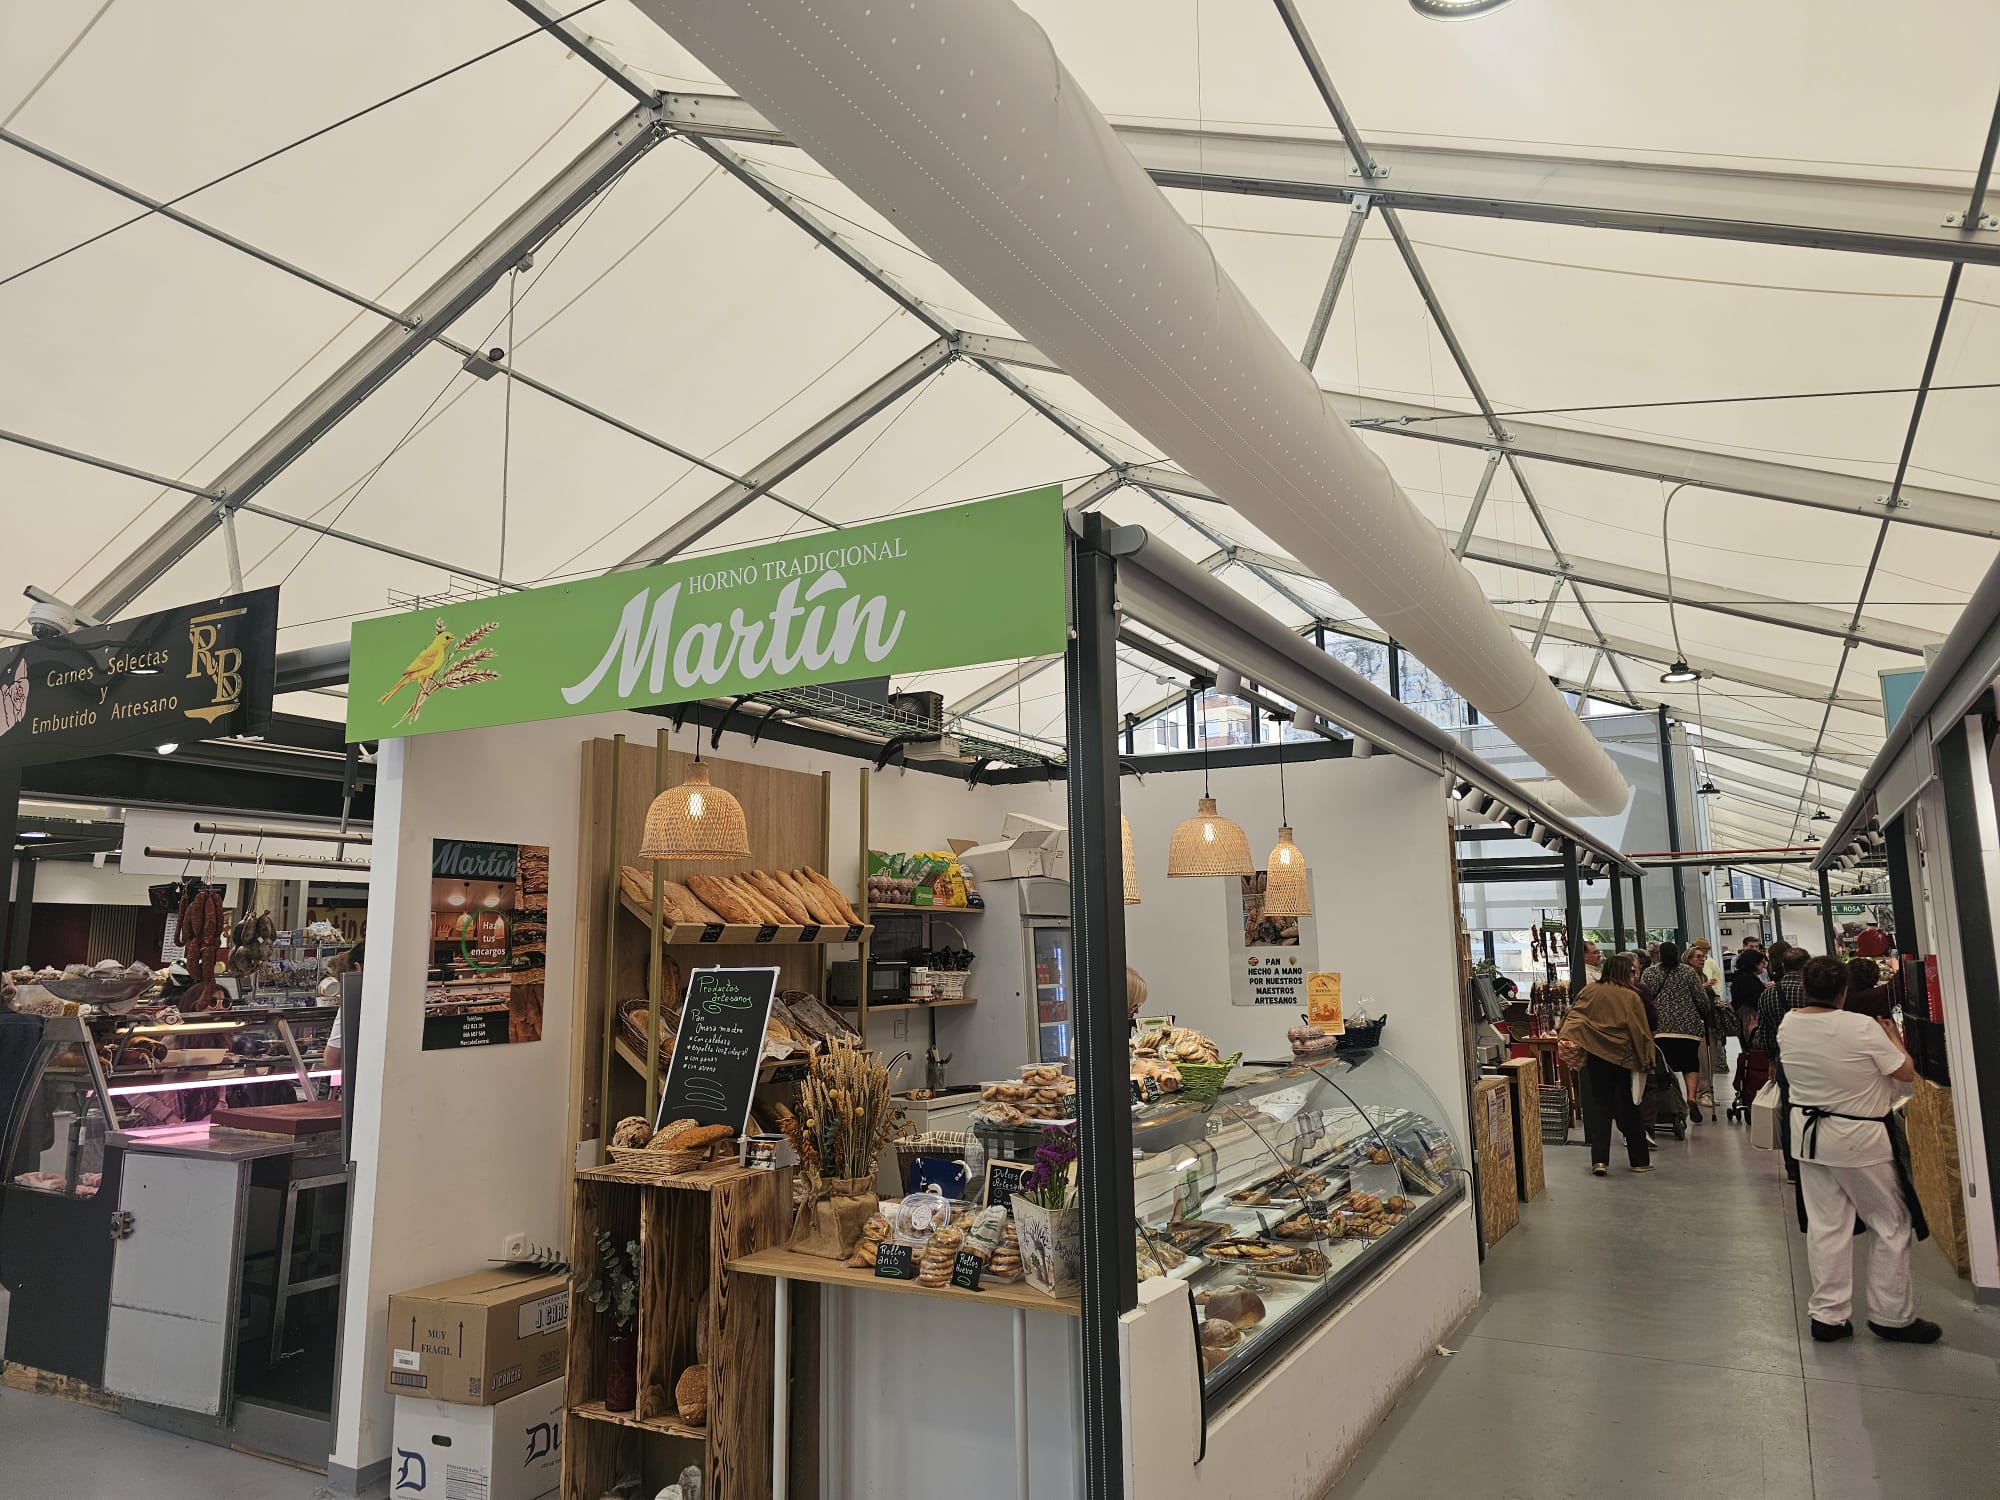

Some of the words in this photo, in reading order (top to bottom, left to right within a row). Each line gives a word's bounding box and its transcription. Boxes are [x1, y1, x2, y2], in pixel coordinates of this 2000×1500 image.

[688, 565, 758, 595] HORNO
[762, 537, 908, 582] TRADICIONAL
[47, 664, 94, 688] Carnes
[107, 649, 169, 676] Selectas
[99, 684, 108, 705] y
[32, 707, 97, 735] Embutido
[111, 694, 178, 721] Artesano
[483, 935, 495, 943] tus
[471, 948, 505, 957] encargos
[1265, 958, 1281, 966] PAN
[1248, 968, 1272, 976] HECHO
[697, 976, 740, 993] Productos
[1249, 977, 1264, 985] POR
[1256, 987, 1295, 995] MAESTROS
[1254, 997, 1298, 1005] ARTESANOS
[691, 1008, 705, 1022] Pan
[880, 1244, 906, 1257] Rollos
[960, 1253, 979, 1269] Rollos
[546, 1301, 568, 1326] GARC
[428, 1329, 447, 1340] MUY
